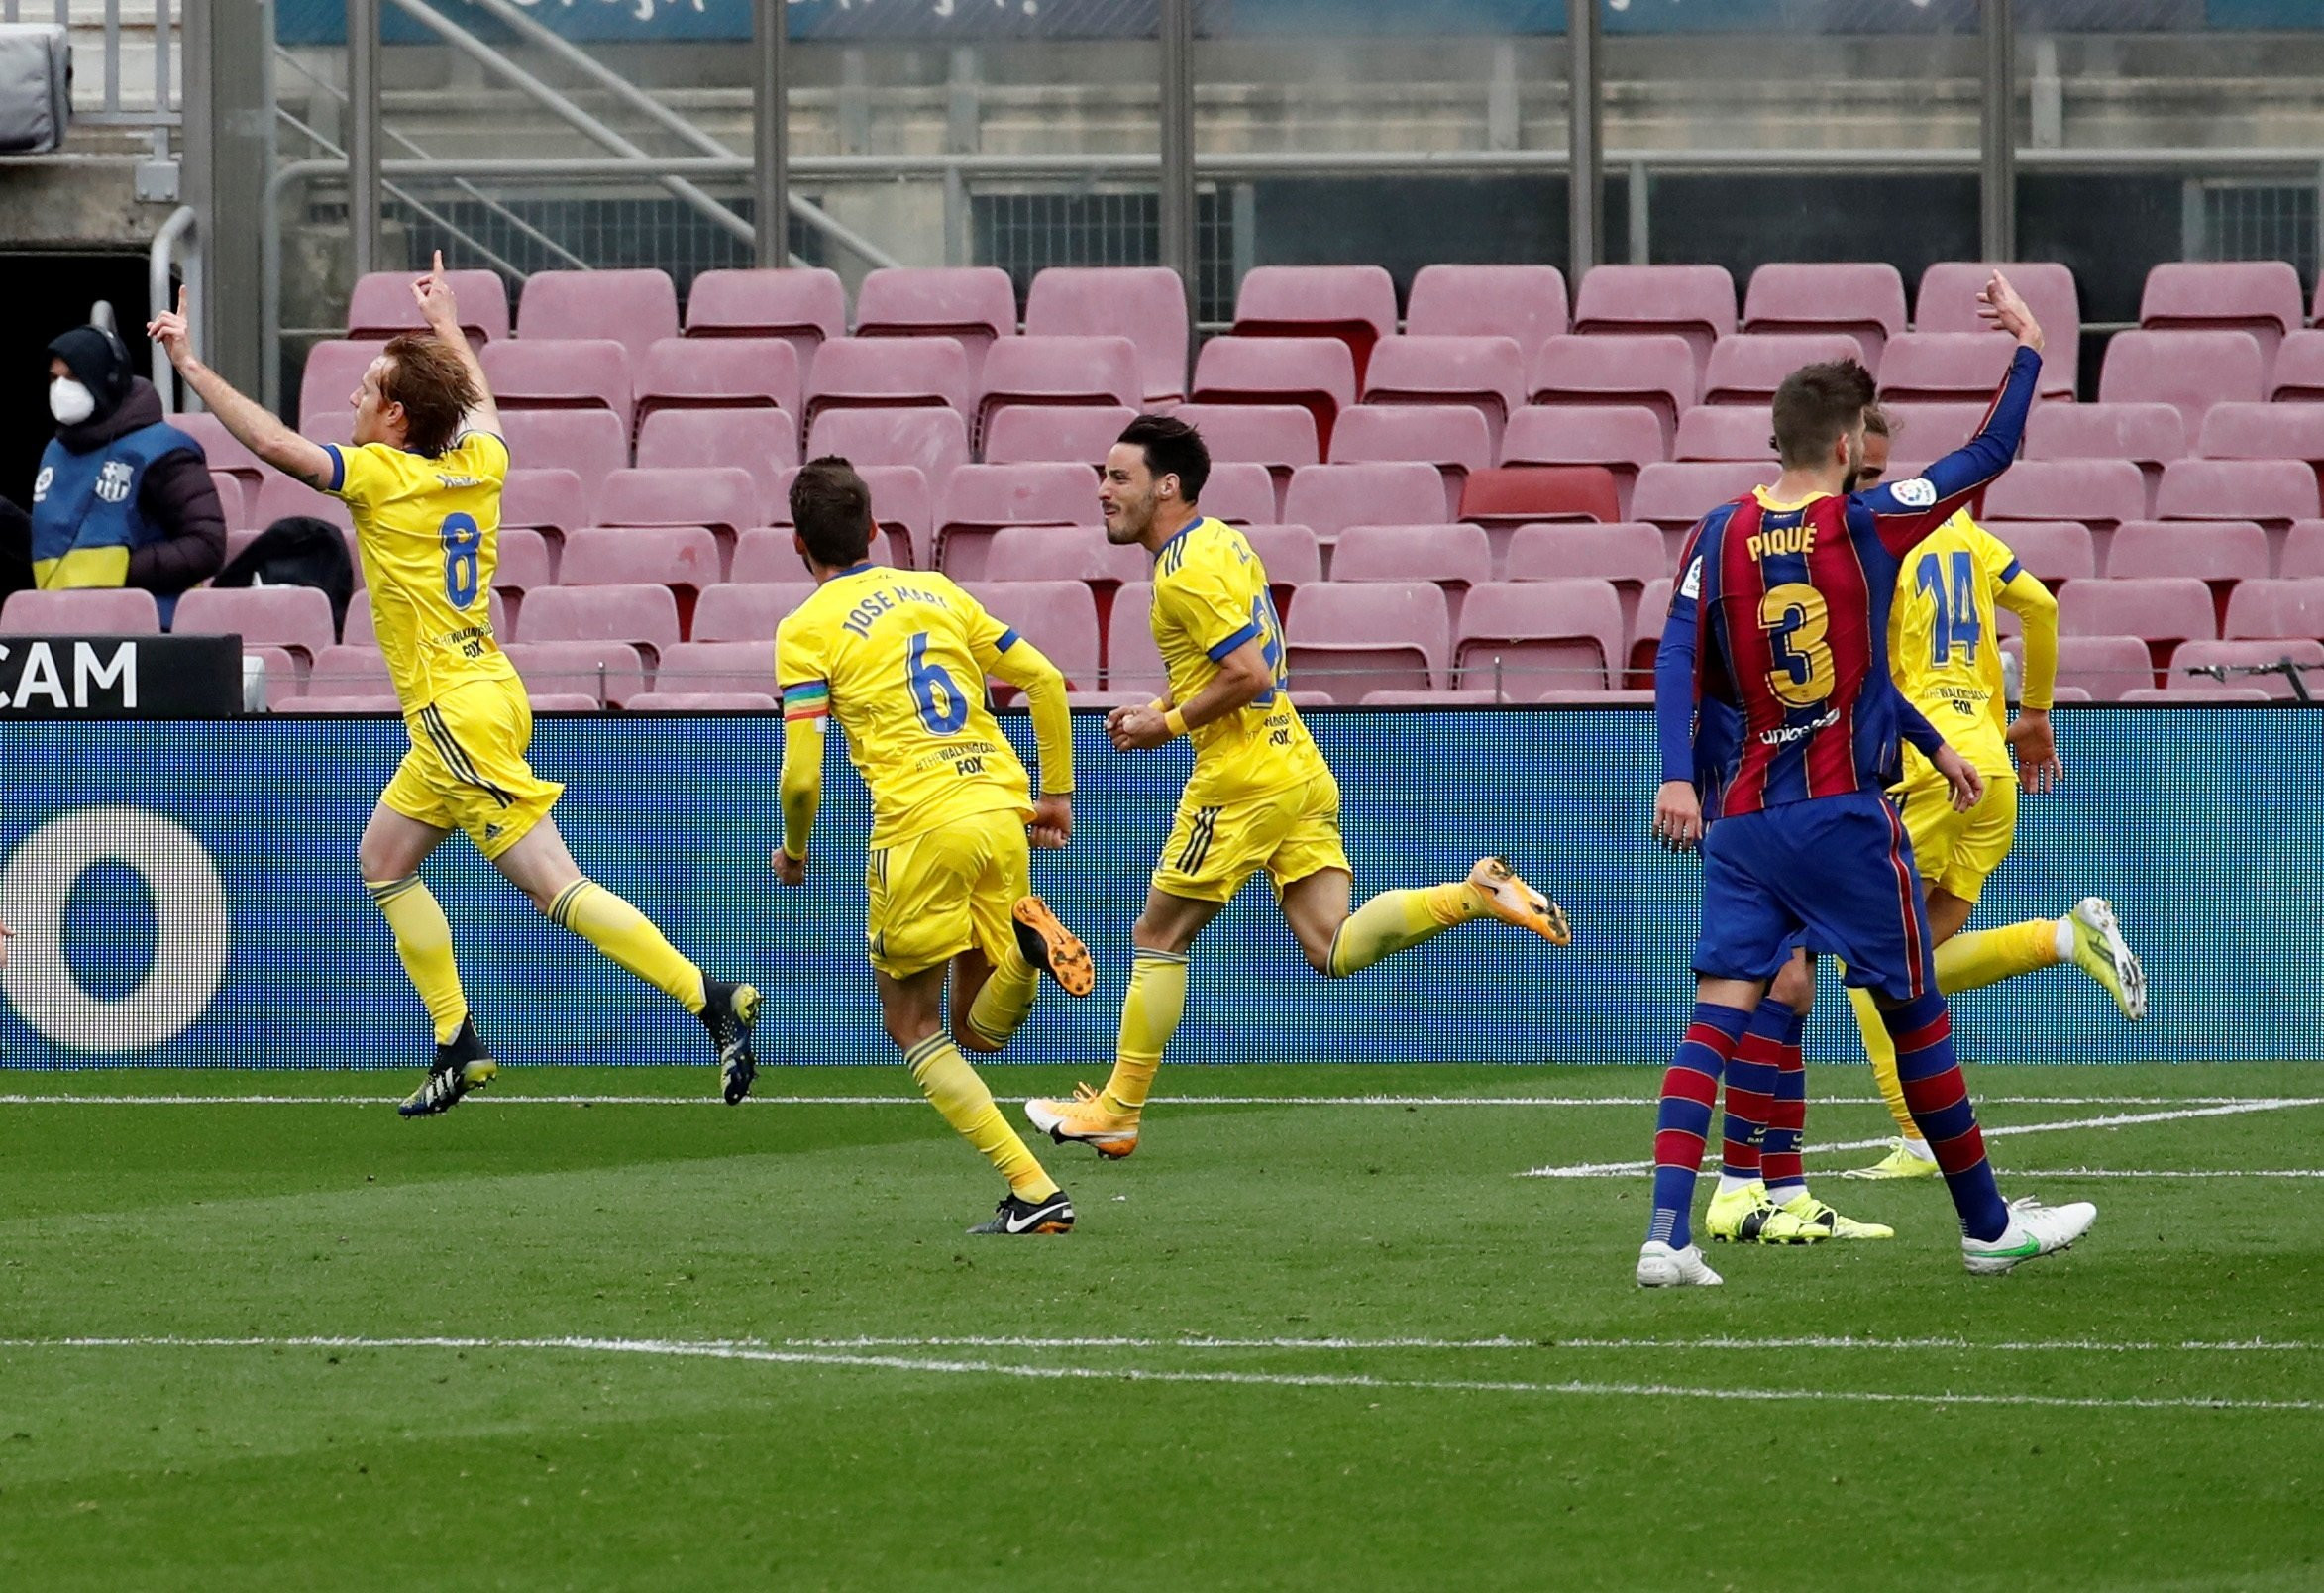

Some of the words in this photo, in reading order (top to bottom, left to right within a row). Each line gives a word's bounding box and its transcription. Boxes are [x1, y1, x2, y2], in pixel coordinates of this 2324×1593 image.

[438, 511, 481, 611] 8
[1746, 522, 1817, 562] PIQUÉ
[842, 591, 895, 640] JOSE
[1916, 551, 1980, 668] 14
[462, 638, 485, 658] FOX
[1757, 583, 1835, 708] 3
[0, 642, 137, 709] AM
[907, 631, 968, 737] 6
[1759, 717, 1829, 745] unice
[955, 756, 986, 776] FOX
